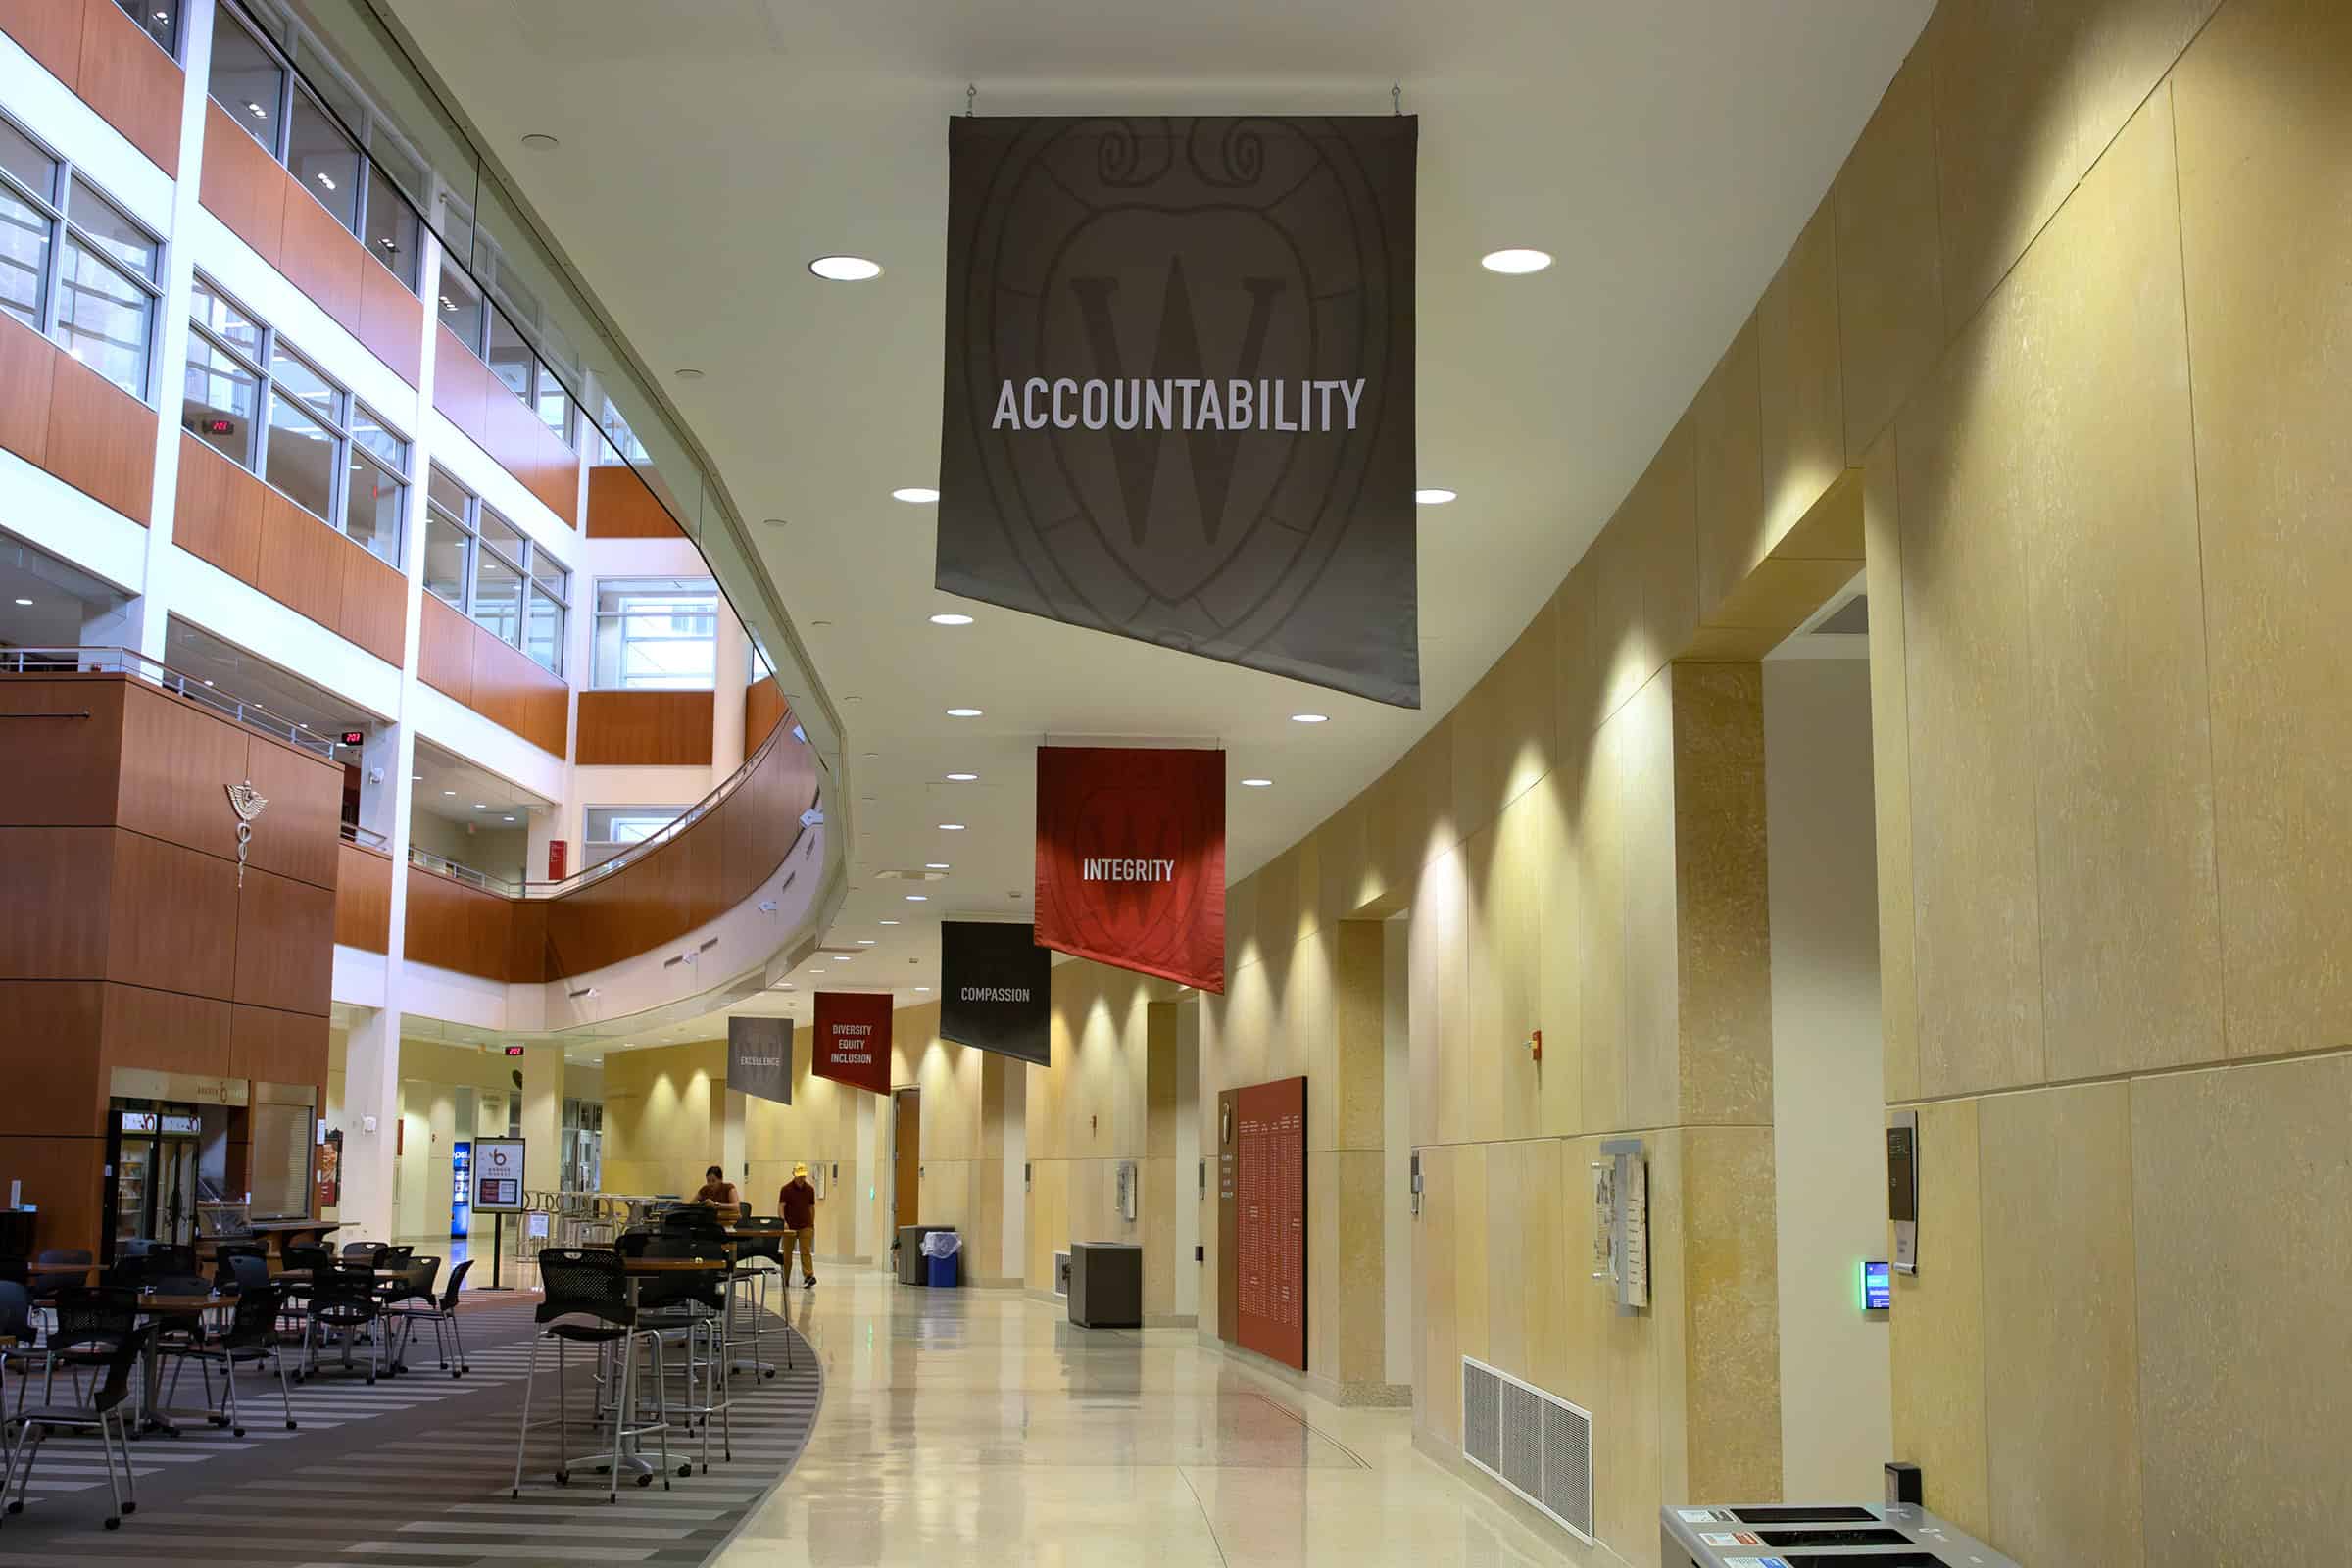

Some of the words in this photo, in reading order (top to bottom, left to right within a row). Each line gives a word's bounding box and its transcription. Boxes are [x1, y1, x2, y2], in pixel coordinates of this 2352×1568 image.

[992, 376, 1366, 432] ACCOUNTABILITY
[1083, 858, 1175, 882] INTEGRITY
[960, 986, 1031, 1003] COMPASSION
[832, 1024, 873, 1036] DIVERSITY
[838, 1039, 865, 1050] EQUITY
[740, 1055, 781, 1067] EXCELLENCE
[831, 1053, 872, 1065] INCLUSION
